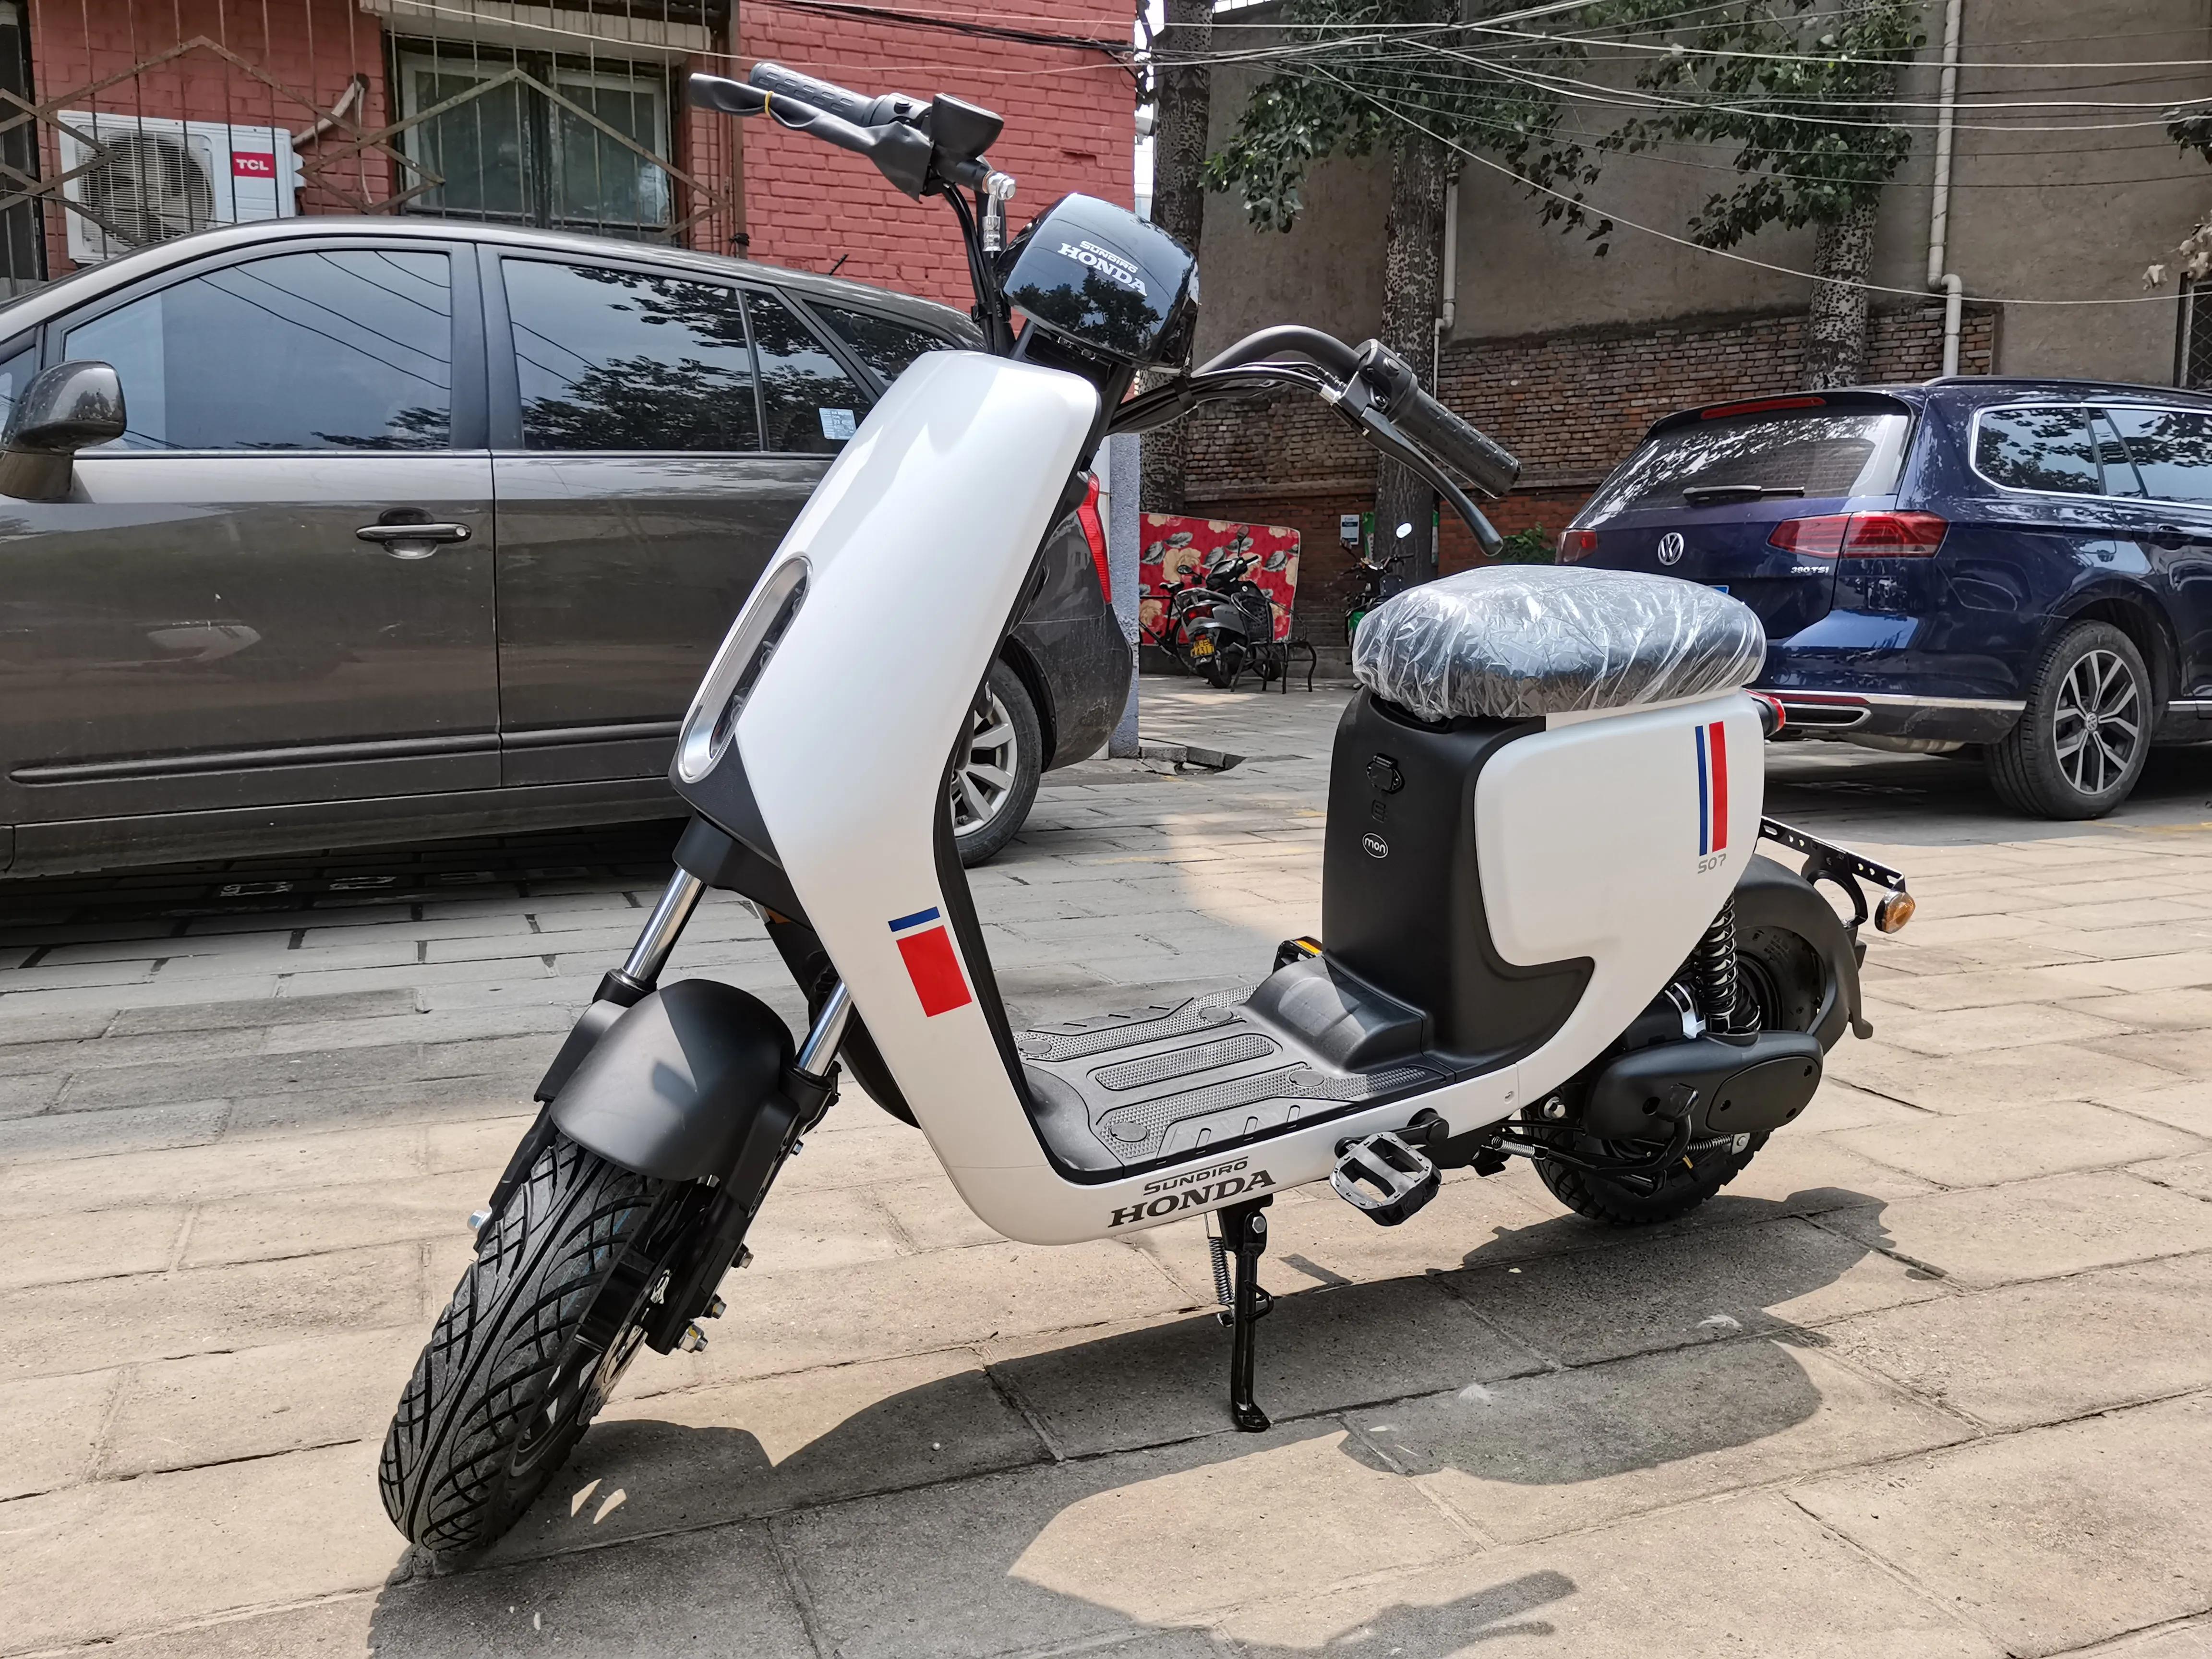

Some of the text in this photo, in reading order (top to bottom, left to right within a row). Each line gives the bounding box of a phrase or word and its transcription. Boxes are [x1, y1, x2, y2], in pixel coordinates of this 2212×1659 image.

[235, 159, 269, 170] TCL
[1058, 242, 1148, 297] HONDA
[1107, 1169, 1276, 1228] HONDA
[1143, 1156, 1249, 1196] SUNDIRO
